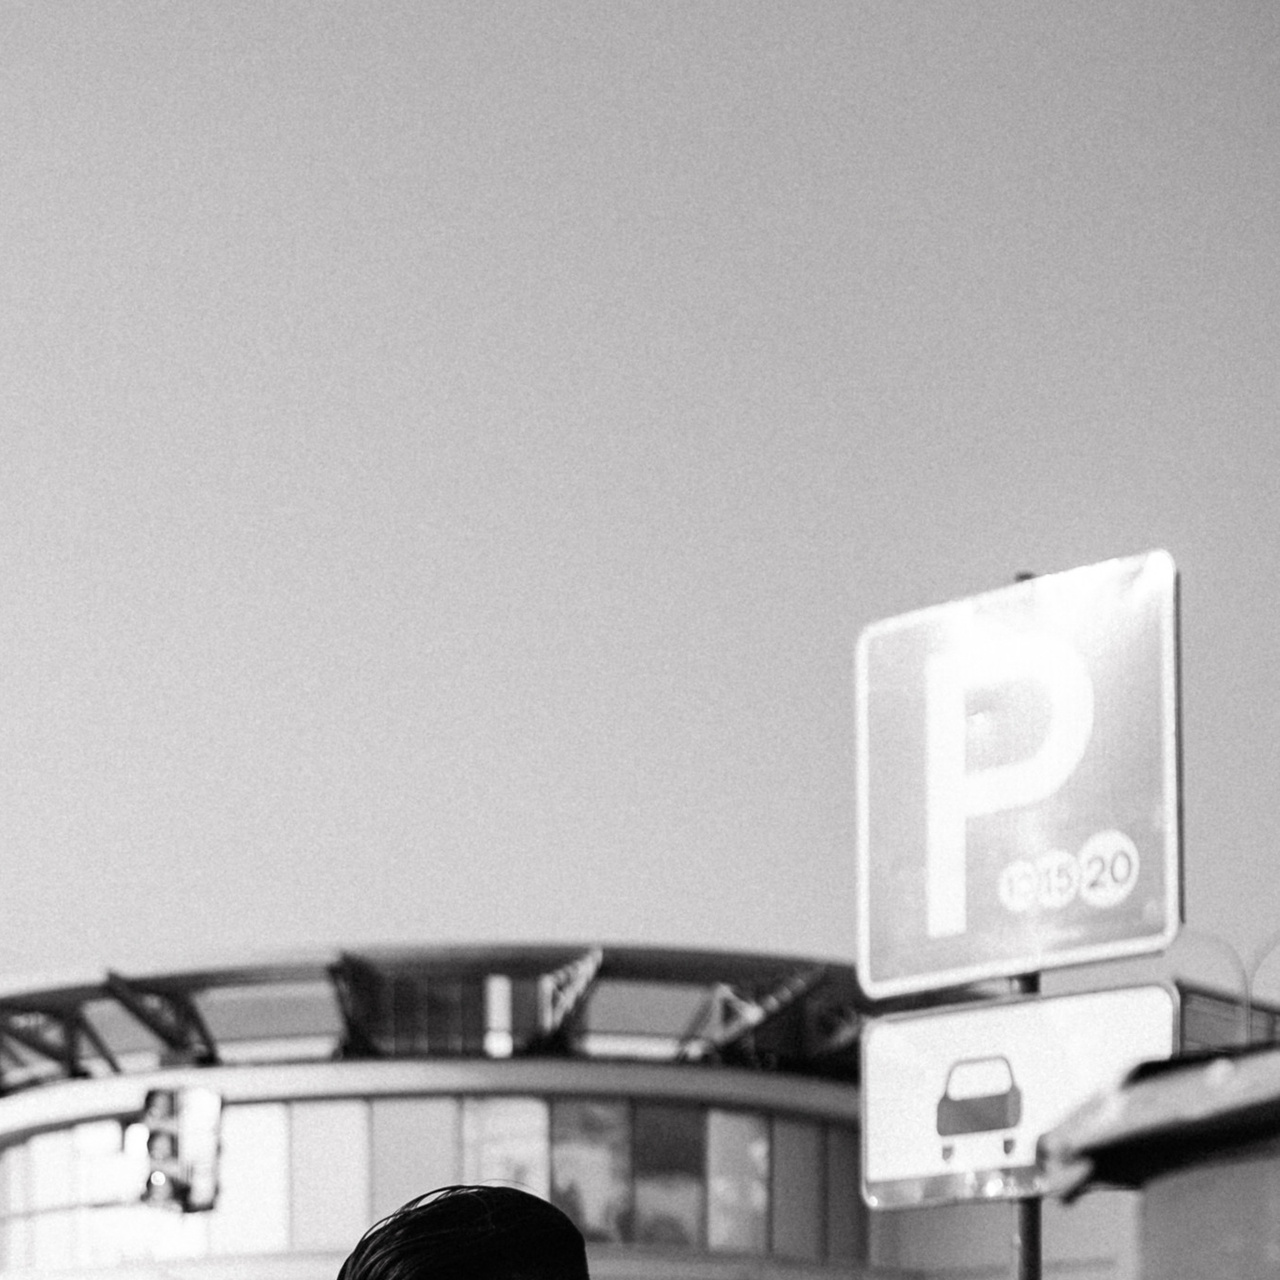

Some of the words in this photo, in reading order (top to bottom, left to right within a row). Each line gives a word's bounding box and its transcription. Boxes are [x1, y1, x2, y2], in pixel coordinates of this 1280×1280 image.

[927, 630, 1093, 938] P
[1044, 862, 1073, 896] 15
[1086, 850, 1133, 890] 20
